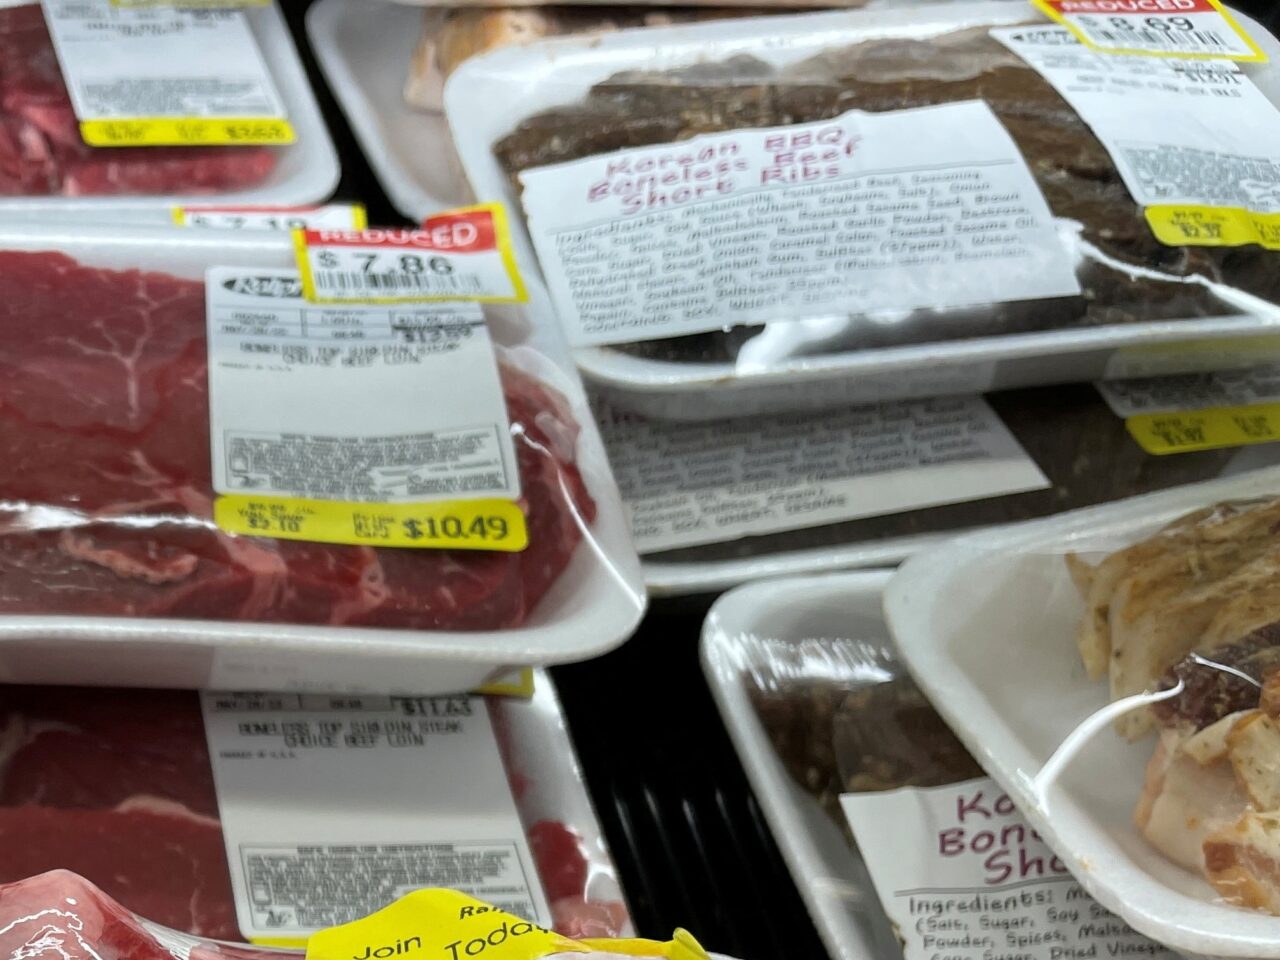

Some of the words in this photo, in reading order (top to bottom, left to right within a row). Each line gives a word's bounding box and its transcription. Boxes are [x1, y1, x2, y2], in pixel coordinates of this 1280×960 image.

[320, 222, 478, 248] REDUCED
[317, 252, 338, 268] $
[352, 252, 453, 274] 7.86
[405, 516, 508, 541] $10.49
[909, 889, 1053, 918] Ingredients:
[979, 913, 1036, 931] Sugar,
[1047, 905, 1080, 924] Soy
[352, 936, 421, 960] Join
[923, 932, 996, 950] Powder,
[1050, 943, 1096, 960] Dried
